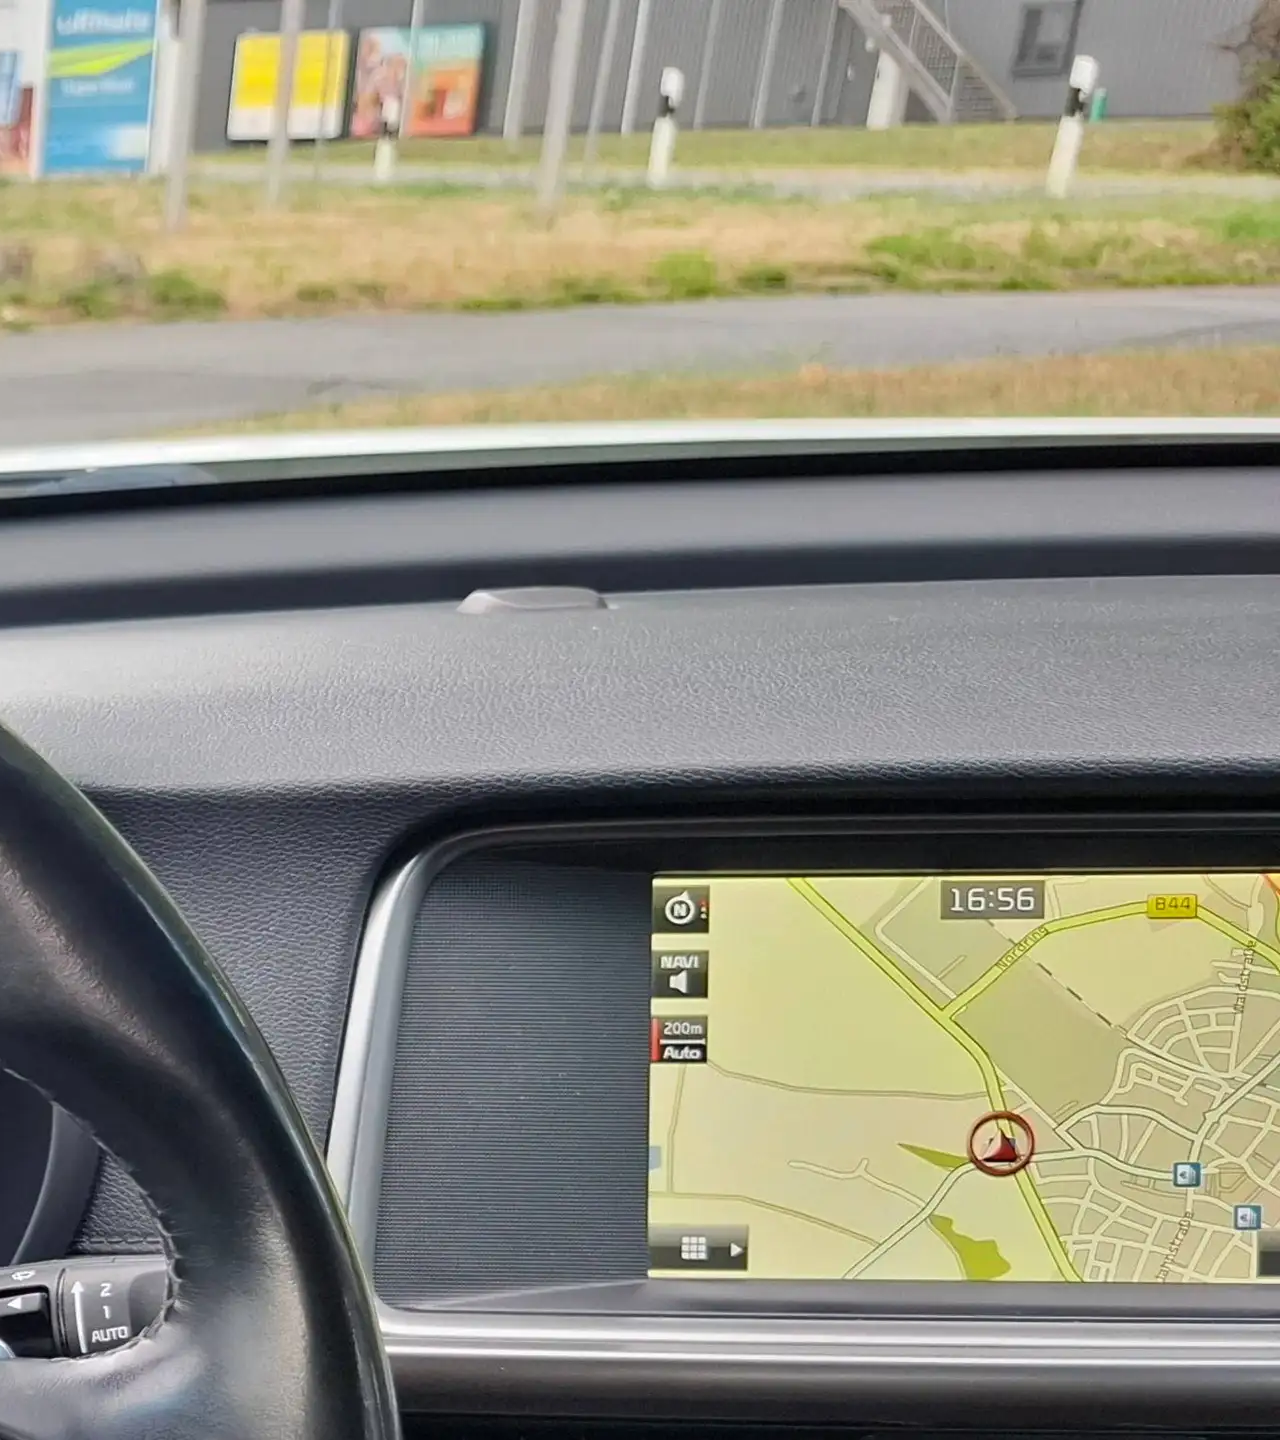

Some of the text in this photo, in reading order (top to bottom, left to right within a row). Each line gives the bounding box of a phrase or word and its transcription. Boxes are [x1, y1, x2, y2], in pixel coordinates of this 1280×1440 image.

[951, 888, 1035, 911] 16:56
[1155, 896, 1191, 910] B44
[995, 925, 1048, 971] Nordring
[660, 955, 699, 968] NAVI
[664, 1022, 702, 1034] 200m
[663, 1047, 701, 1059] Auto
[100, 1283, 111, 1297] 2
[103, 1306, 110, 1319] 1
[92, 1326, 129, 1343] AUTO
